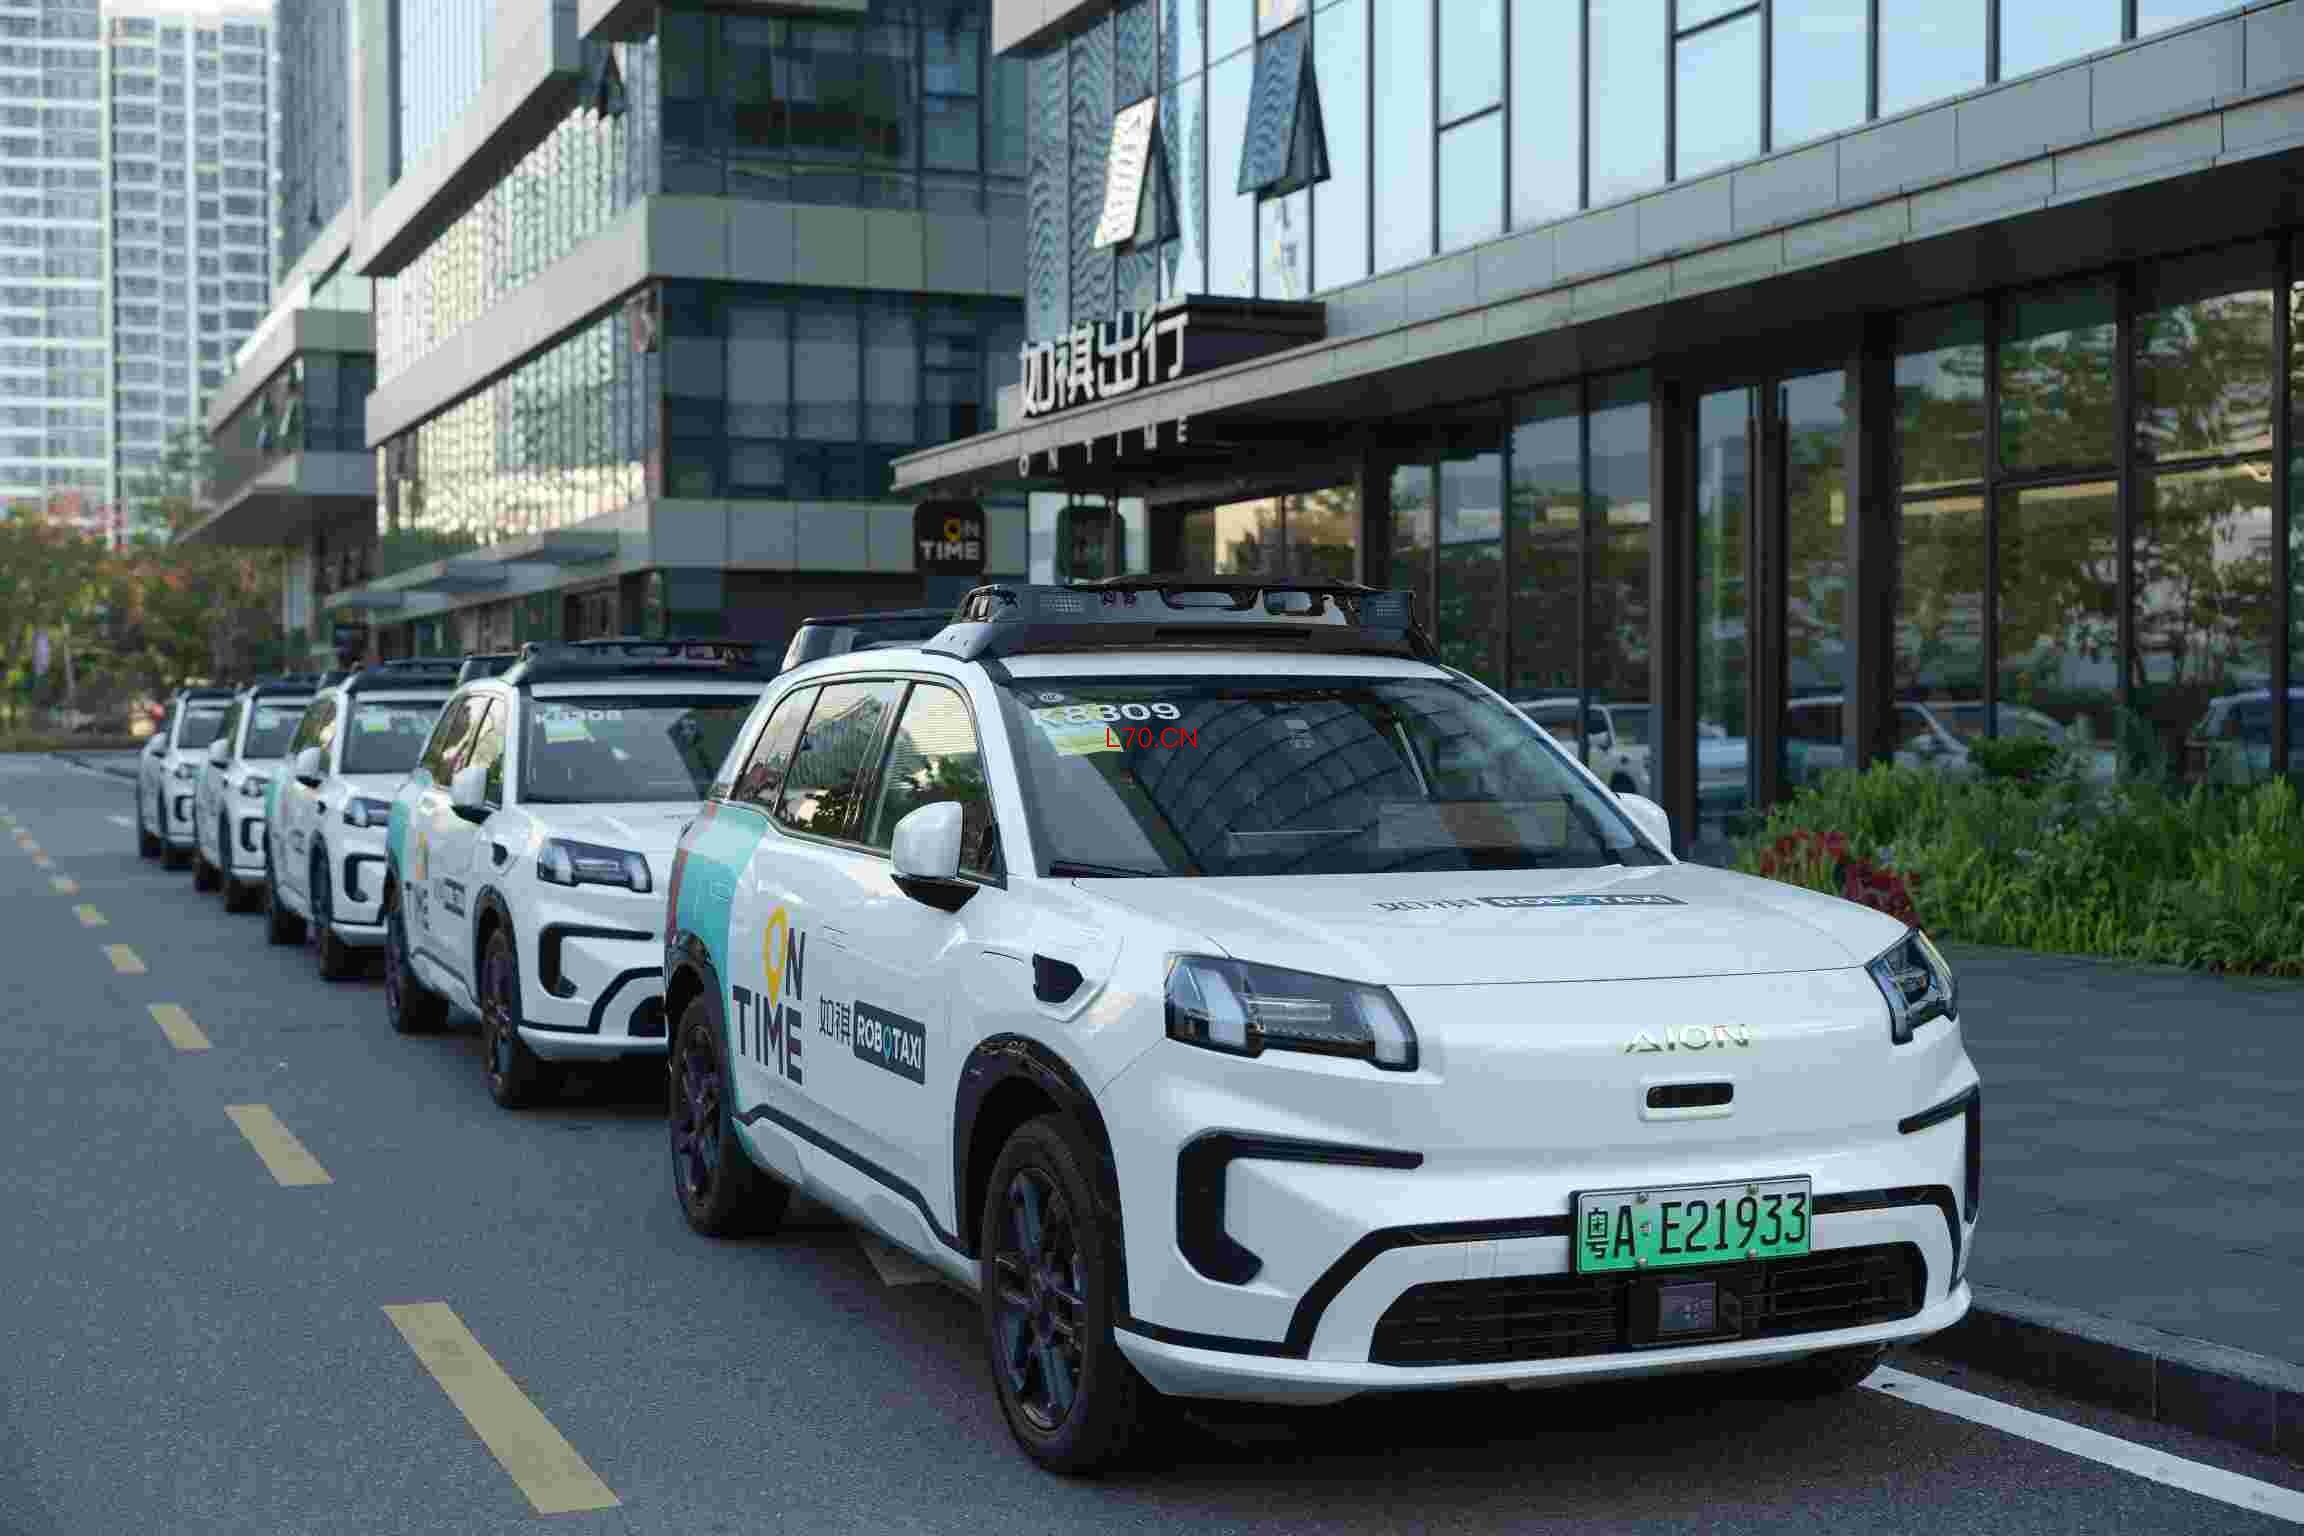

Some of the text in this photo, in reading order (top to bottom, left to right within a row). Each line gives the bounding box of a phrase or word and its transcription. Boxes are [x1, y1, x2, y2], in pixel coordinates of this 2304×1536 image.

[1018, 303, 1189, 417] 如祺出行
[919, 540, 981, 561] TIME
[943, 517, 981, 543] ON
[762, 904, 806, 1009] ON
[732, 984, 803, 1086] TIME
[856, 1014, 922, 1070] ROBOTAXI
[1623, 1023, 1752, 1054] AION
